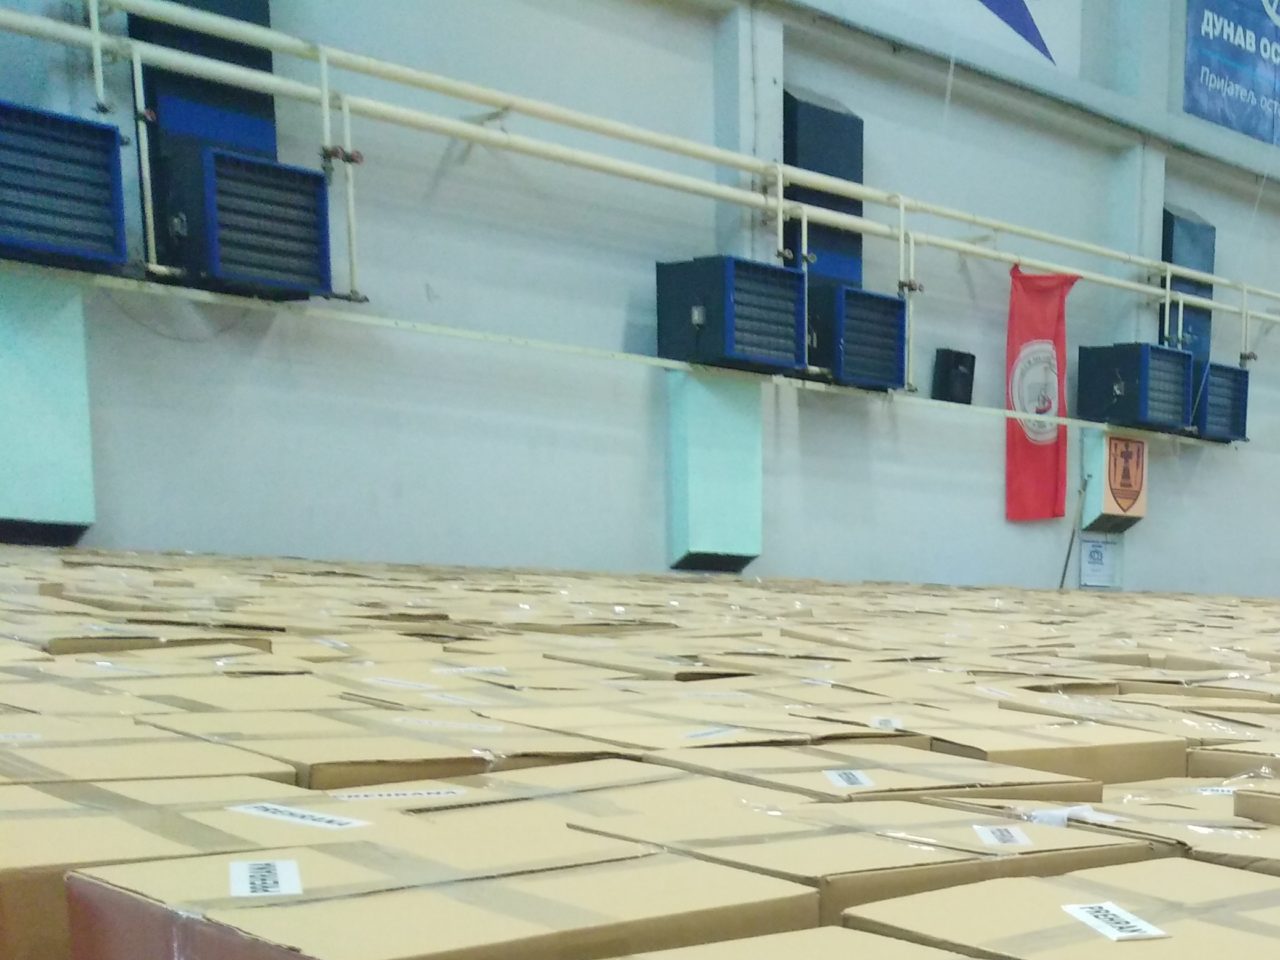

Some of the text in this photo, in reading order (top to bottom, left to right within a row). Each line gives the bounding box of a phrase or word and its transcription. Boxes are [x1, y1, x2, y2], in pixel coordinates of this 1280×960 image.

[1201, 9, 1256, 53] ДУНАВ
[1200, 65, 1257, 106] Пријатељ
[248, 862, 280, 893] PREHRANA
[1079, 905, 1147, 934] PREHRAN
